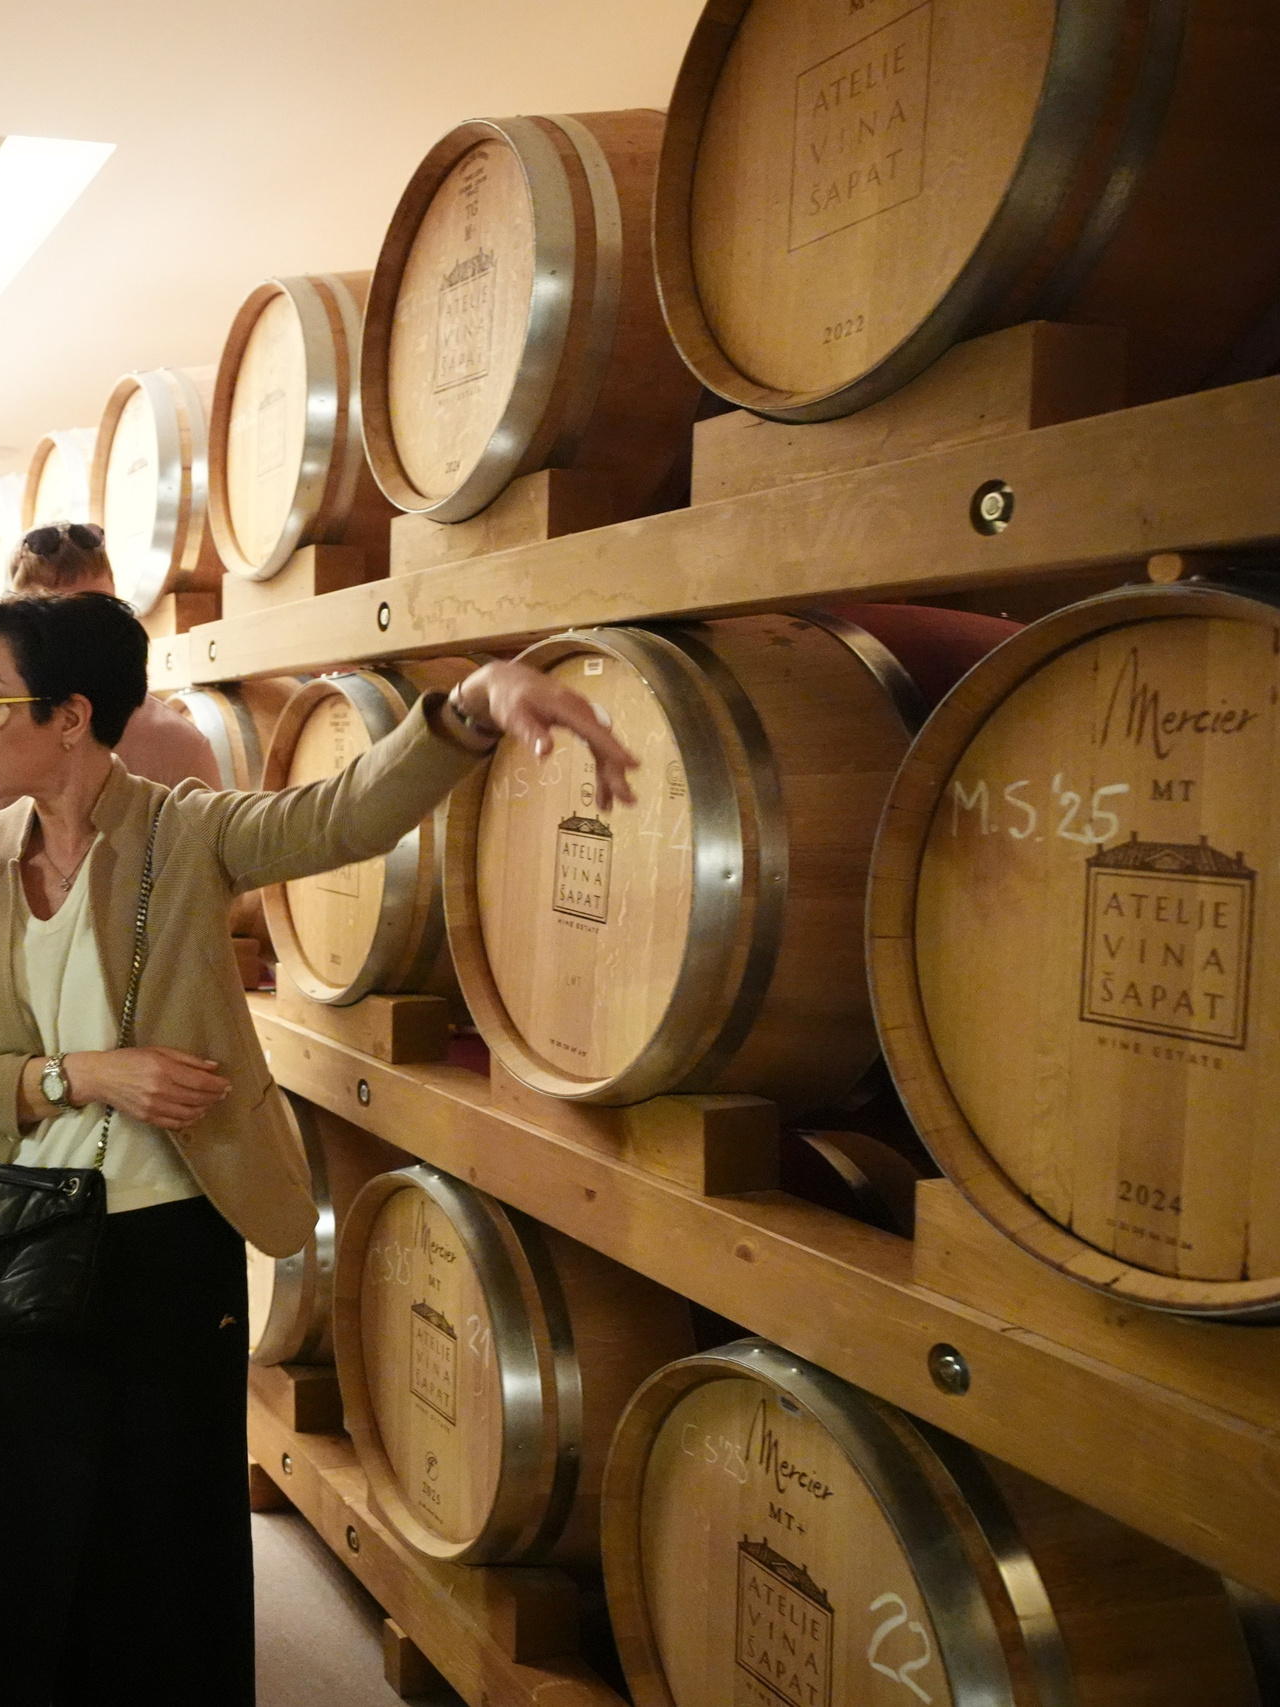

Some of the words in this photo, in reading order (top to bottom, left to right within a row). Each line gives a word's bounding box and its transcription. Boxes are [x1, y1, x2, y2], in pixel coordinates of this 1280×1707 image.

[809, 98, 906, 164] VINA
[807, 147, 904, 217] ŠAPAT
[822, 315, 865, 345] 2022
[1099, 646, 1259, 760] Mercier
[1149, 779, 1196, 802] MT
[561, 841, 605, 865] ATELJE
[560, 865, 603, 887] VINA
[559, 884, 602, 910] ŠAPAT
[1103, 891, 1230, 930] ATELJE
[558, 917, 574, 929] WINE
[576, 922, 600, 935] ESTATE
[1103, 932, 1227, 975] VINA
[1100, 970, 1225, 1022] ŠAPAT
[1096, 1033, 1142, 1055] WINE
[1152, 1046, 1223, 1071] ESTATE
[1117, 1178, 1184, 1216] 2024
[415, 1326, 452, 1363] ATELJE
[415, 1350, 451, 1387] VINA
[744, 1398, 835, 1501] Mercier
[767, 1500, 806, 1536] MT+
[747, 1576, 820, 1642] ATELJE
[747, 1604, 819, 1675] VINA
[867, 1592, 932, 1705] 22
[747, 1634, 819, 1705] ŠAPAT
